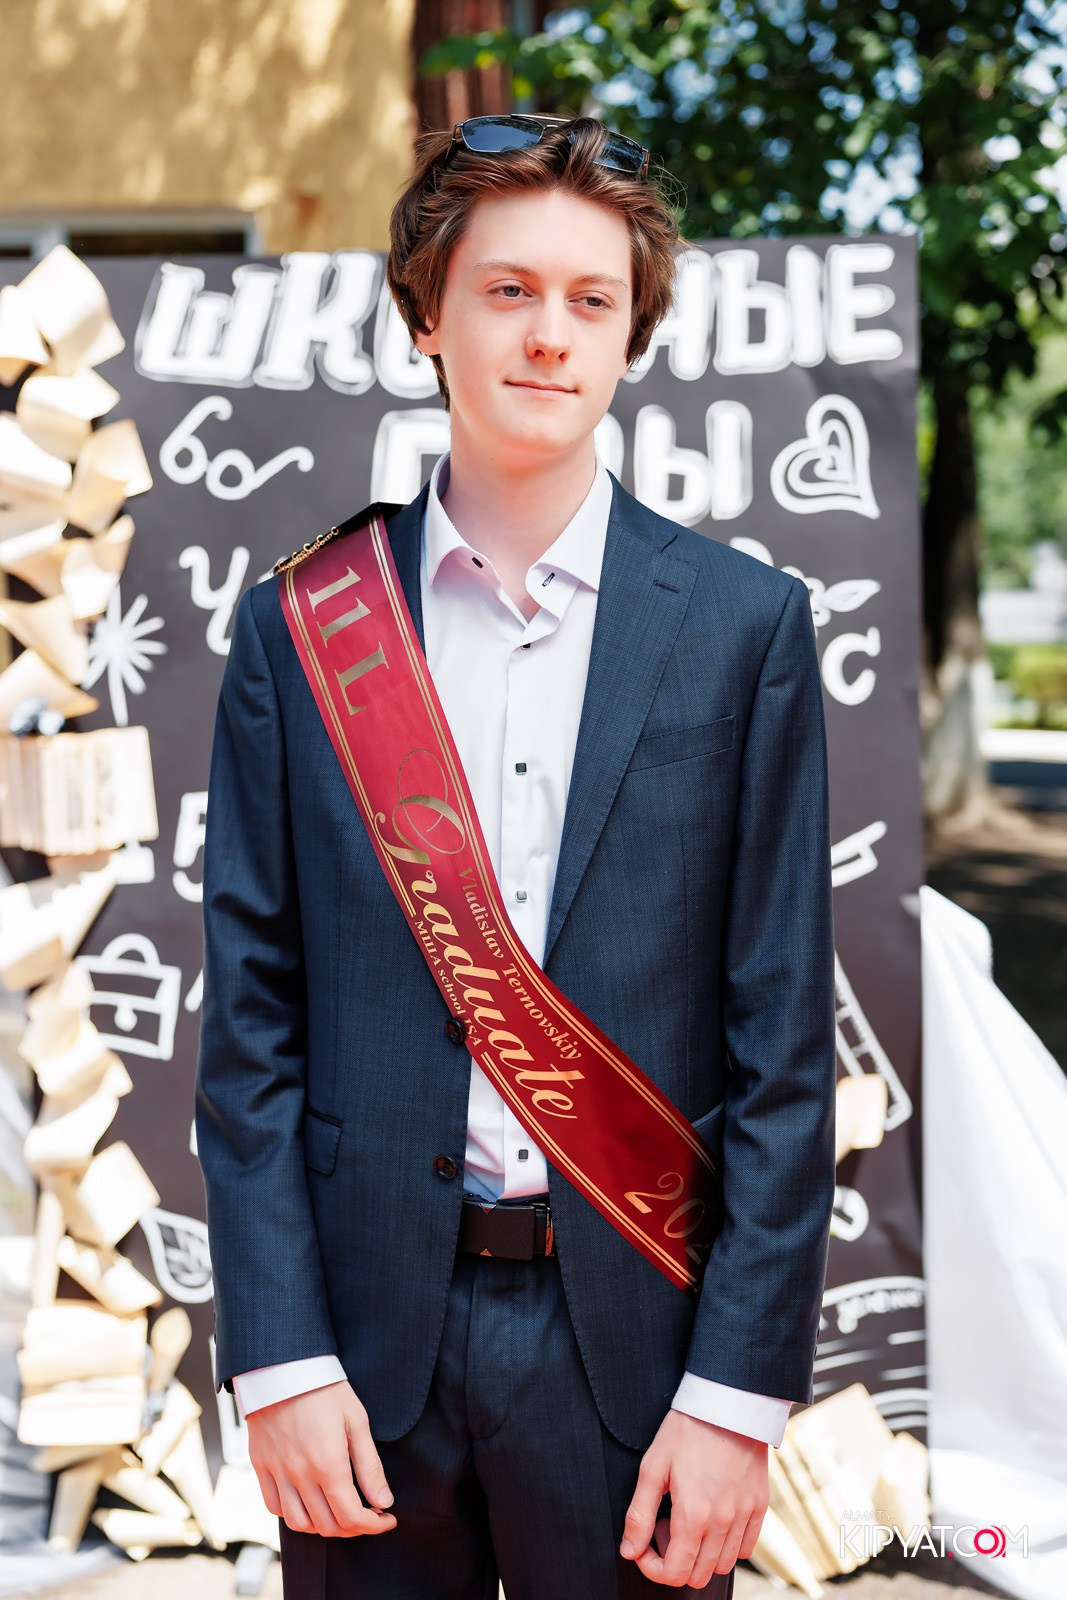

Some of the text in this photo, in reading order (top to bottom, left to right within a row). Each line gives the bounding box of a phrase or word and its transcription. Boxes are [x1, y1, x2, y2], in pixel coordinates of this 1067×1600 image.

[373, 748, 586, 1119] Graduate
[437, 969, 467, 1015] school
[458, 866, 582, 1060] Vladislav Ternovskiy
